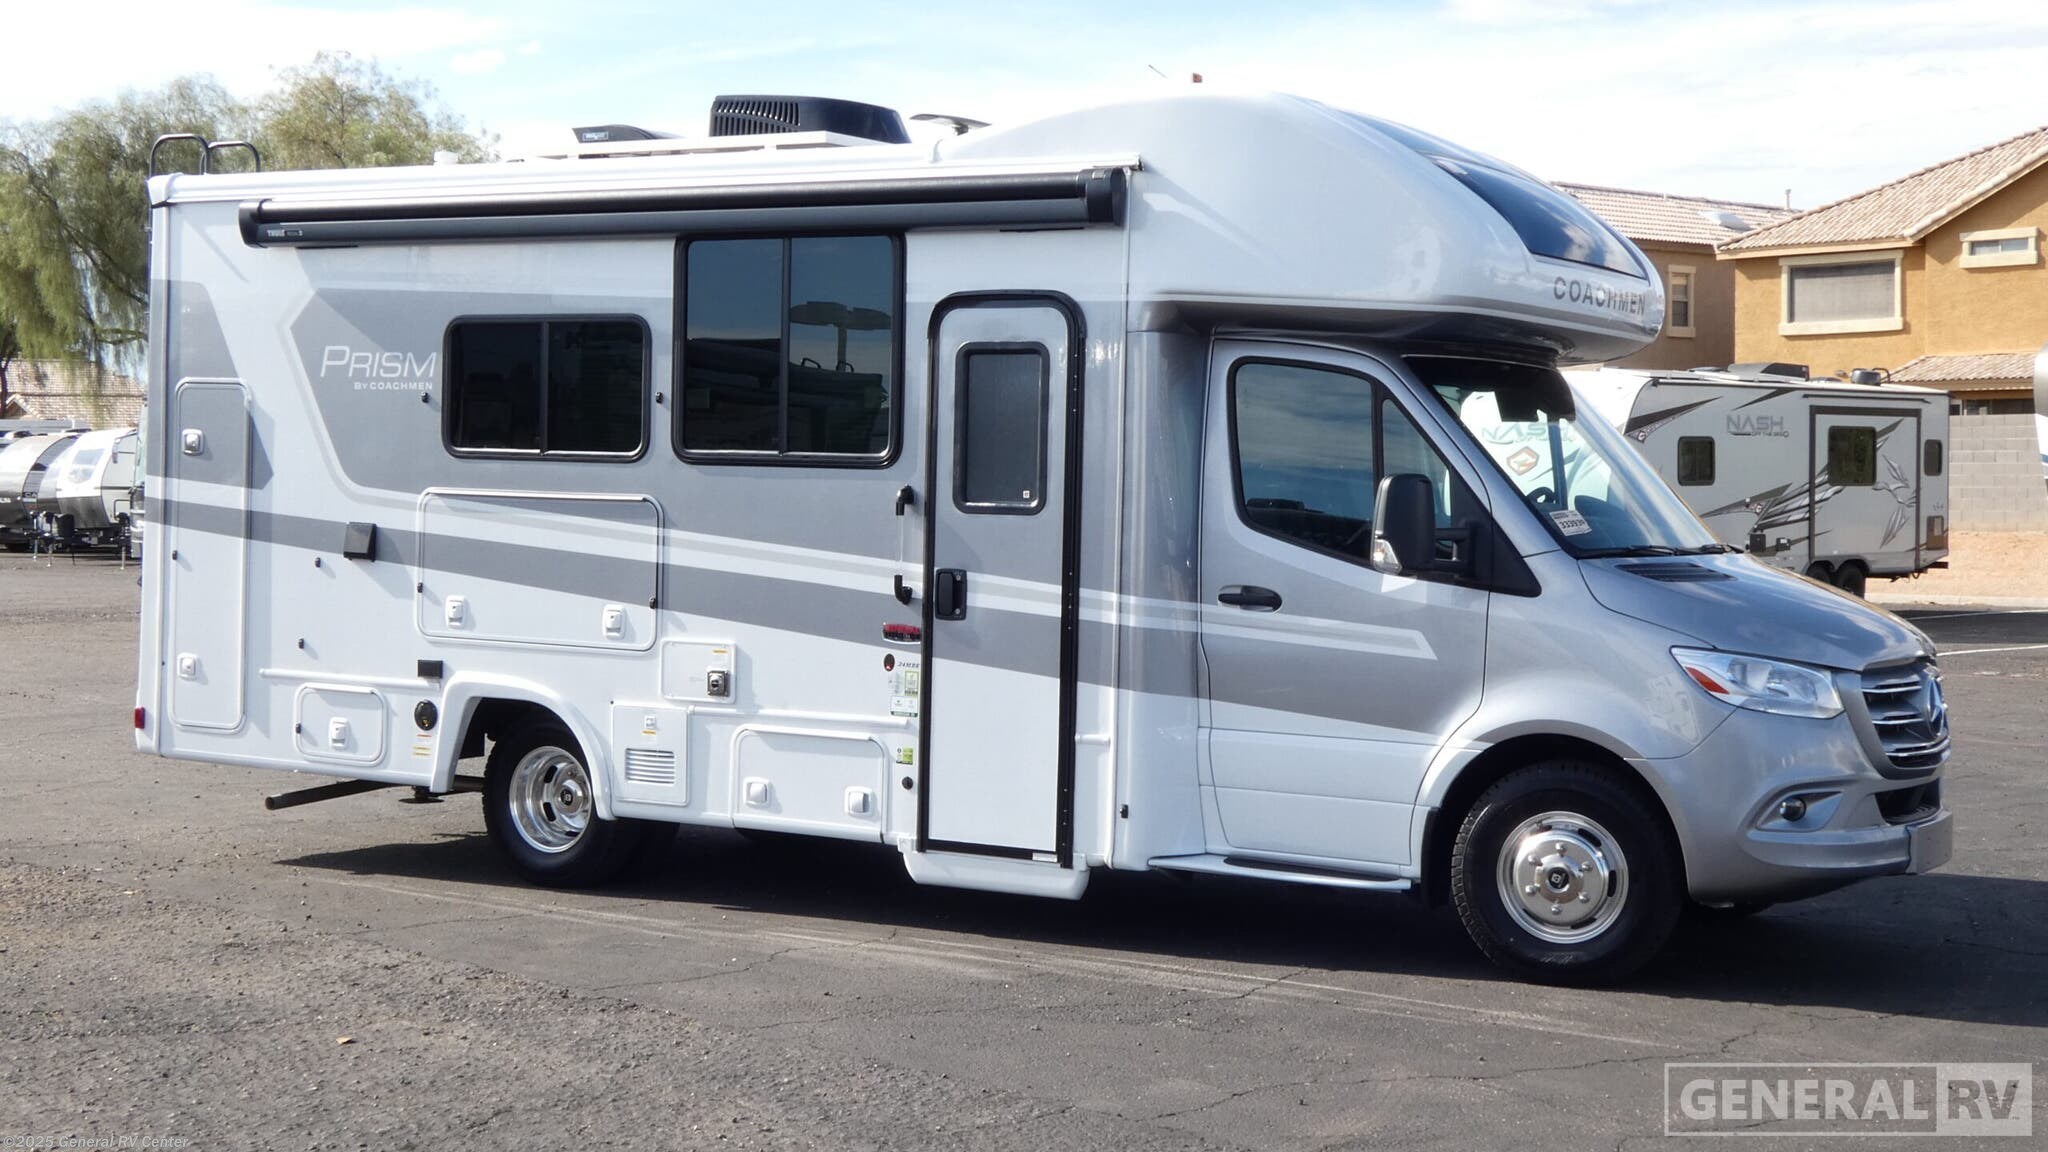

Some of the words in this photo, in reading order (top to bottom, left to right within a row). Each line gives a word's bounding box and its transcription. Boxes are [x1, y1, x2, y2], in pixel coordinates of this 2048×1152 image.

[1553, 276, 1646, 316] COACHMEN
[320, 345, 437, 378] PRISM
[369, 382, 433, 390] COACHMEN
[1726, 414, 1784, 431] NASH
